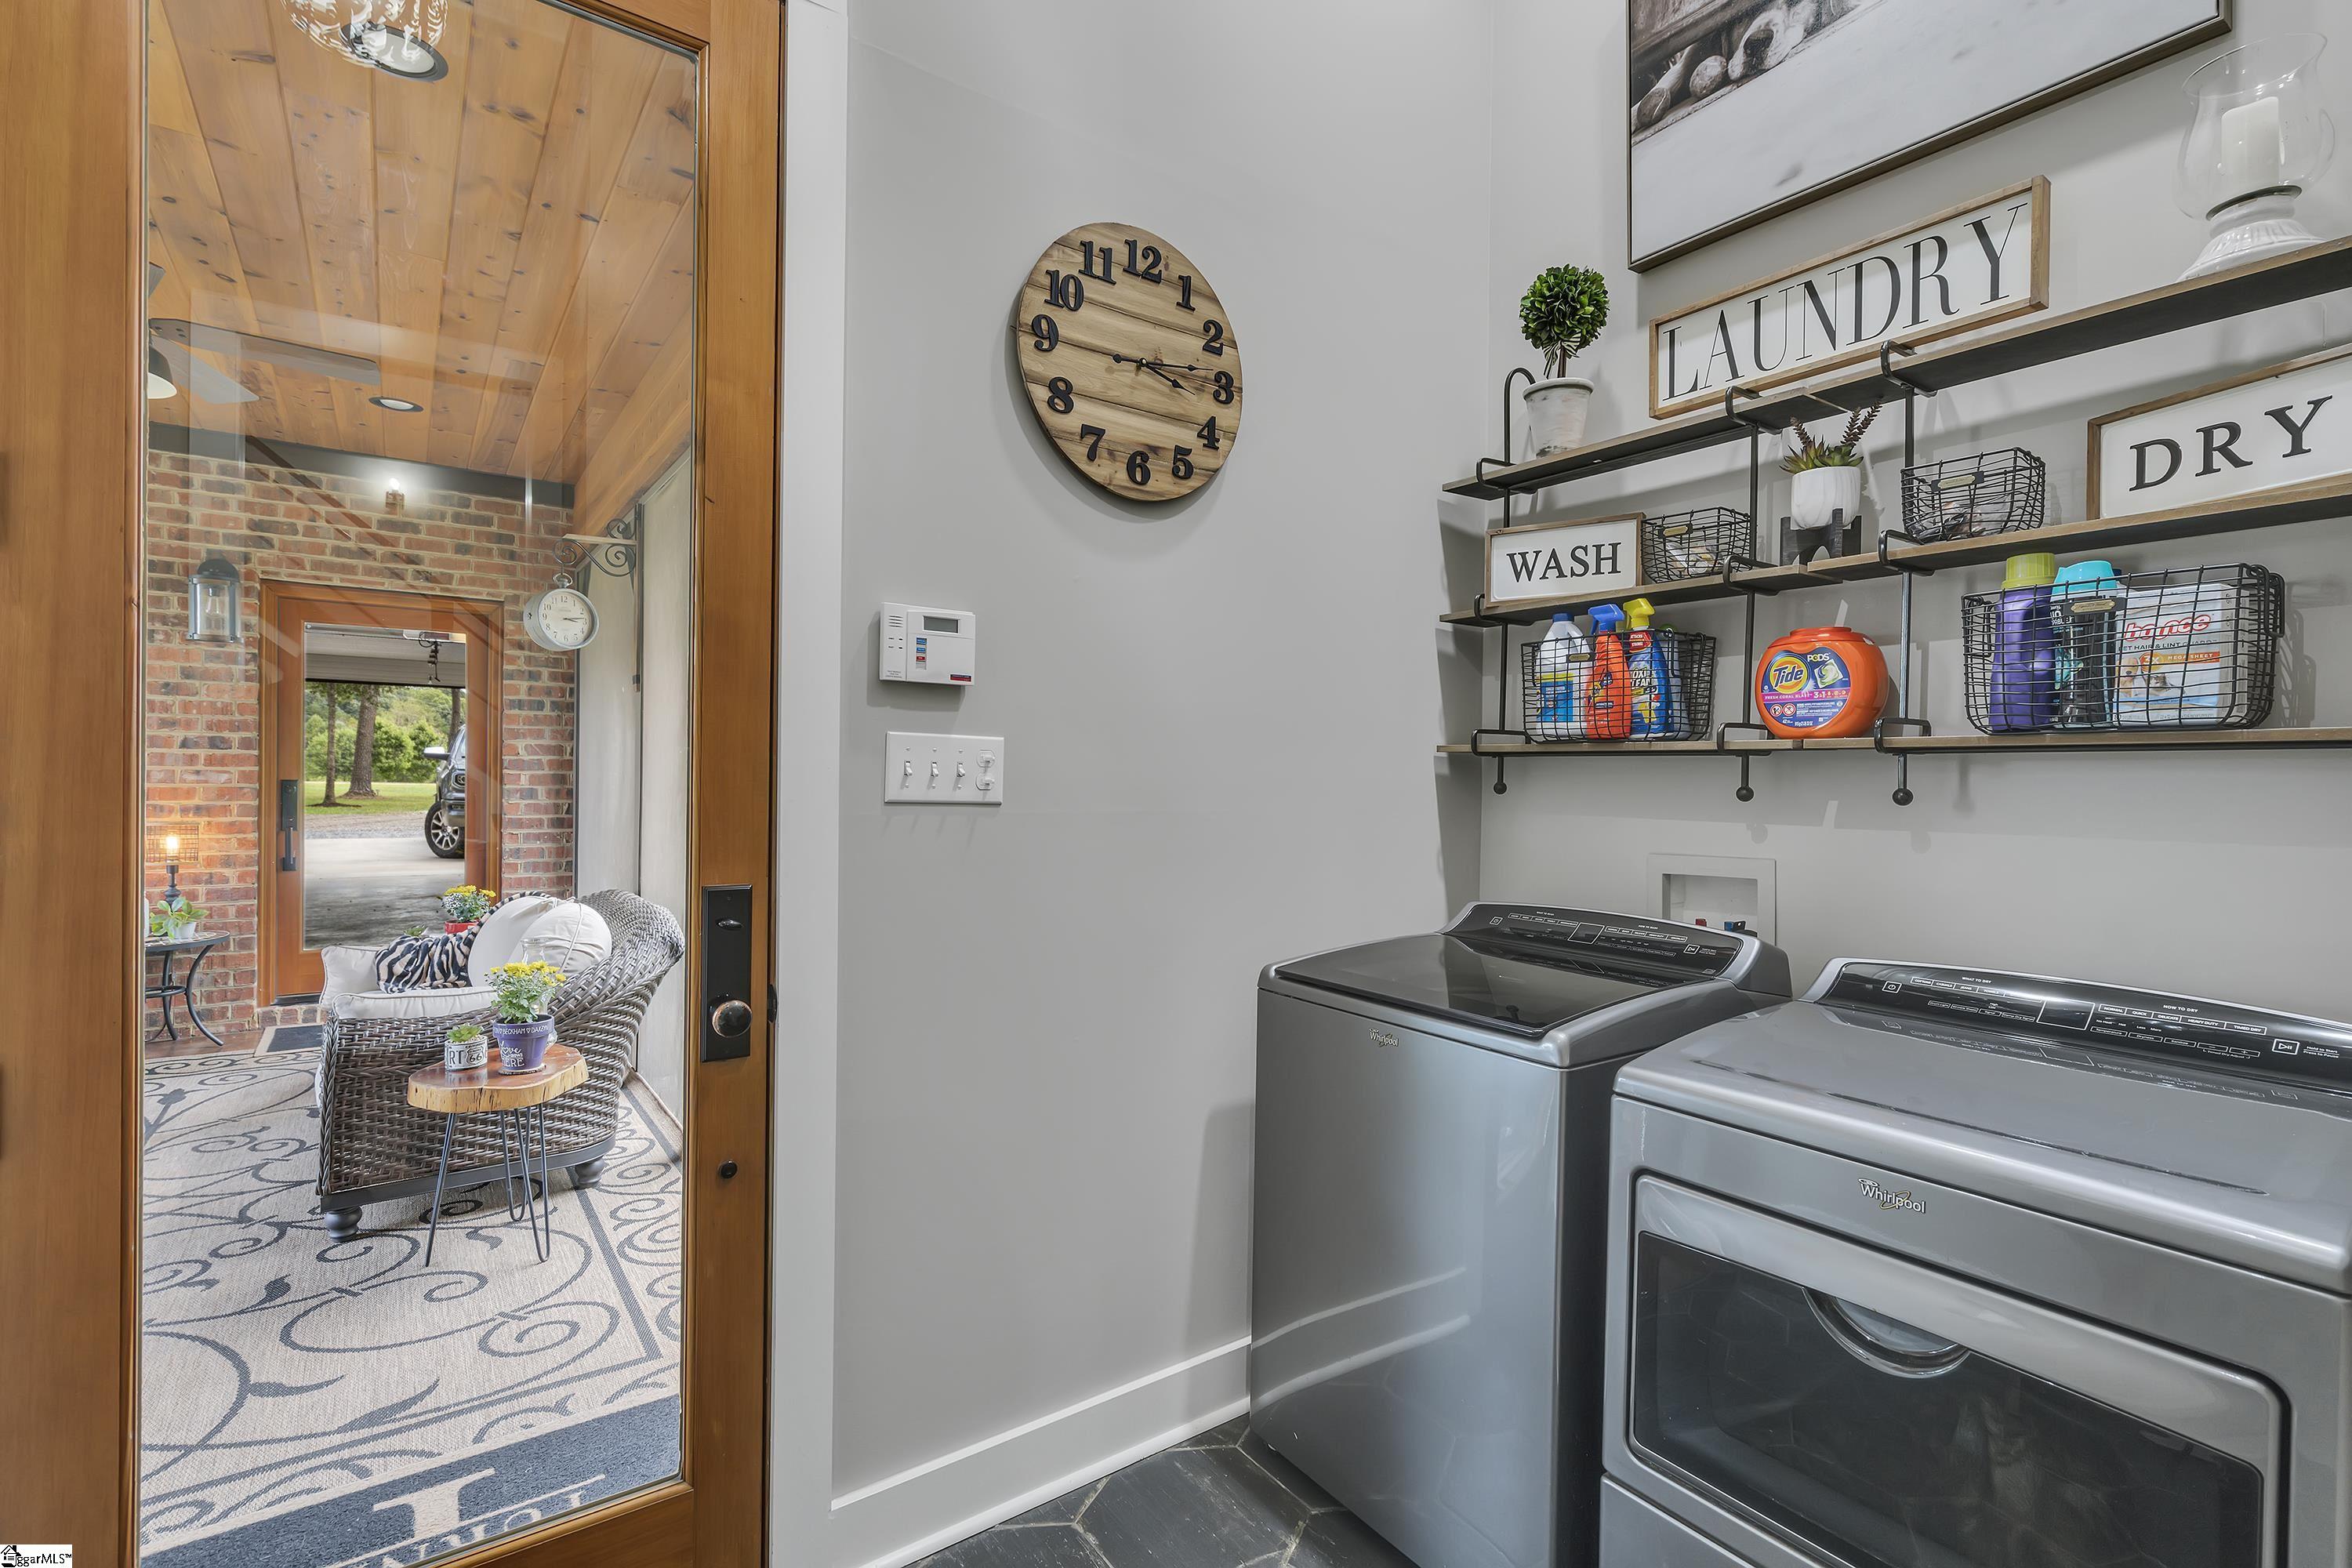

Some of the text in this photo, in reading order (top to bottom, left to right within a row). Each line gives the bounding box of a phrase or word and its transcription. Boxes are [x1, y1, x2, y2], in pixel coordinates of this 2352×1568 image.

[1078, 240, 1116, 285] 11
[1123, 239, 1163, 284] 12
[1044, 269, 1084, 312] 10
[1176, 274, 1196, 312] 1
[1662, 202, 2029, 401] LAUNDRY
[1031, 314, 1059, 352] 9
[1203, 319, 1224, 356] 2
[1047, 376, 1073, 413] 8
[1213, 370, 1235, 405] 3
[1081, 423, 1105, 462] 7
[1197, 416, 1220, 451] 4
[2129, 394, 2333, 492] DRY
[1126, 450, 1151, 485] 6
[1172, 445, 1194, 480] 5
[1505, 542, 1622, 583] WASH
[2124, 615, 2211, 641] bounce
[1807, 653, 1830, 662] PODS
[1773, 664, 1804, 689] Tide
[1370, 1029, 1398, 1047] Whirlpool
[449, 1051, 482, 1065] RT 66
[1859, 1179, 1926, 1213] Whirlpool
